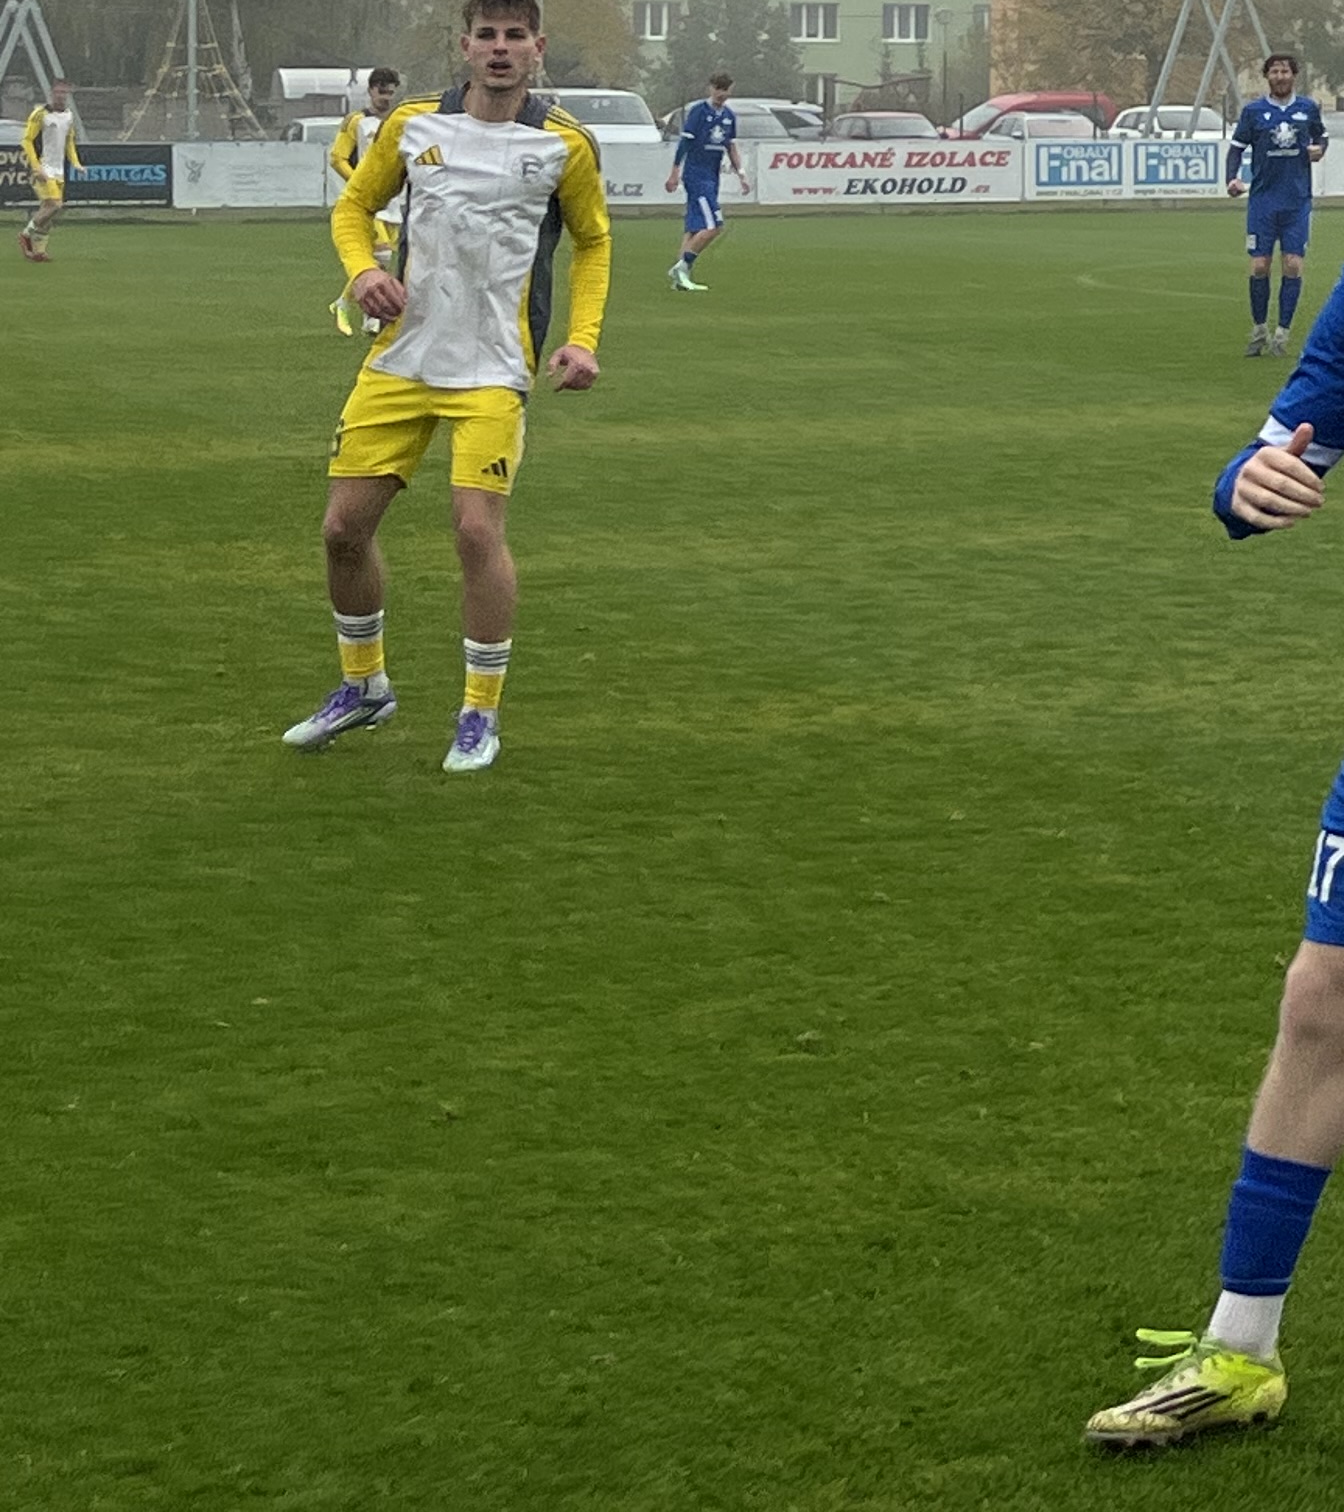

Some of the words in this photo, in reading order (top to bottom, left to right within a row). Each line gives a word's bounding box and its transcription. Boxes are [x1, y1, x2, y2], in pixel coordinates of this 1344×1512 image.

[769, 148, 896, 169] FOUKANÉ
[904, 150, 1011, 168] IZOLACE
[1063, 146, 1112, 159] OBALY
[1160, 145, 1208, 158] OBALY
[1039, 146, 1119, 182] Final
[1138, 145, 1214, 180] Final
